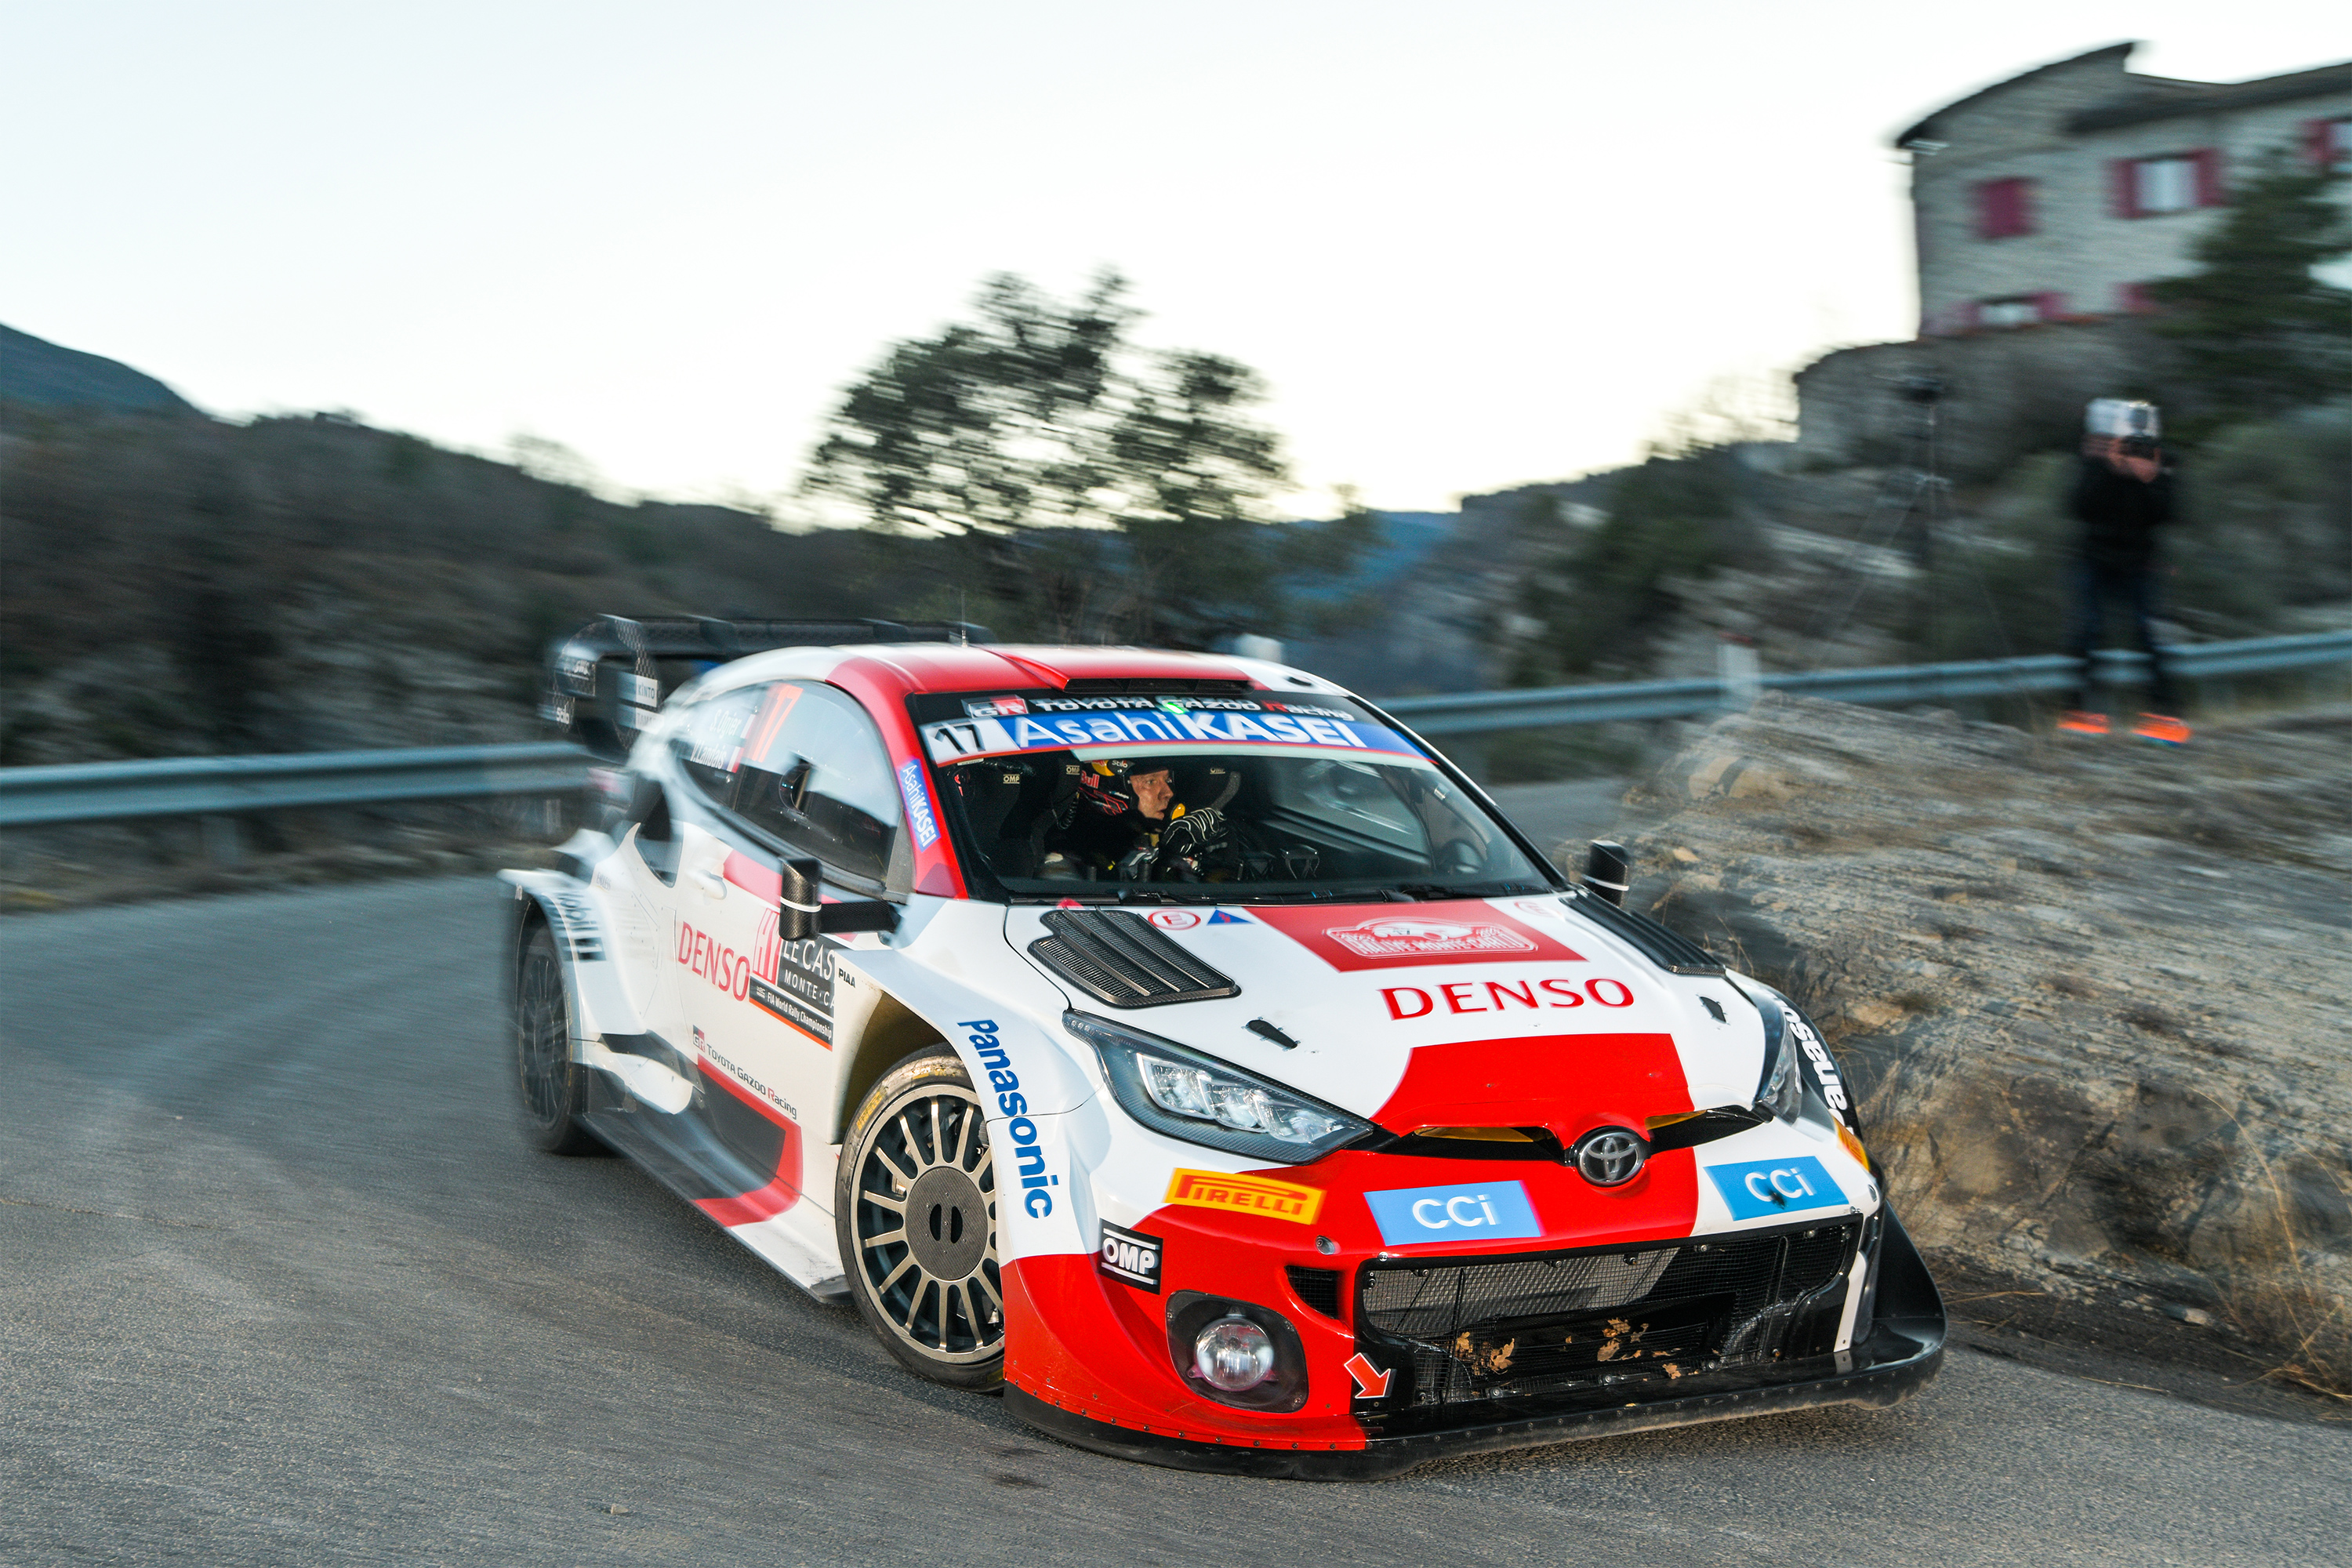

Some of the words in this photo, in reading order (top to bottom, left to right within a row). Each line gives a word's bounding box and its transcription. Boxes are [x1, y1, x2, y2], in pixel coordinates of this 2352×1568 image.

[752, 684, 804, 763] 17
[935, 724, 986, 755] 17
[1017, 710, 1367, 748] AsahiKASEI
[1030, 696, 1155, 712] TOYOTA
[1156, 696, 1261, 713] GAZOO
[1262, 699, 1356, 721] Racing
[902, 764, 937, 848] AsahiKASEI
[677, 921, 750, 1001] DENSO
[838, 967, 856, 989] PIAA
[767, 992, 775, 1004] FIA
[775, 995, 788, 1013] World
[788, 1004, 800, 1021] Rally
[800, 1011, 833, 1040] Championship
[1377, 978, 1635, 1022] DENSO
[706, 1043, 736, 1075] TOYOTA
[737, 1066, 766, 1096] GAZOO
[768, 1087, 797, 1120] Racing
[1773, 994, 1855, 1136] anaso
[957, 1019, 1058, 1219] Panasonic
[1174, 1174, 1308, 1215] PIRELLI
[1102, 1236, 1158, 1275] OMP
